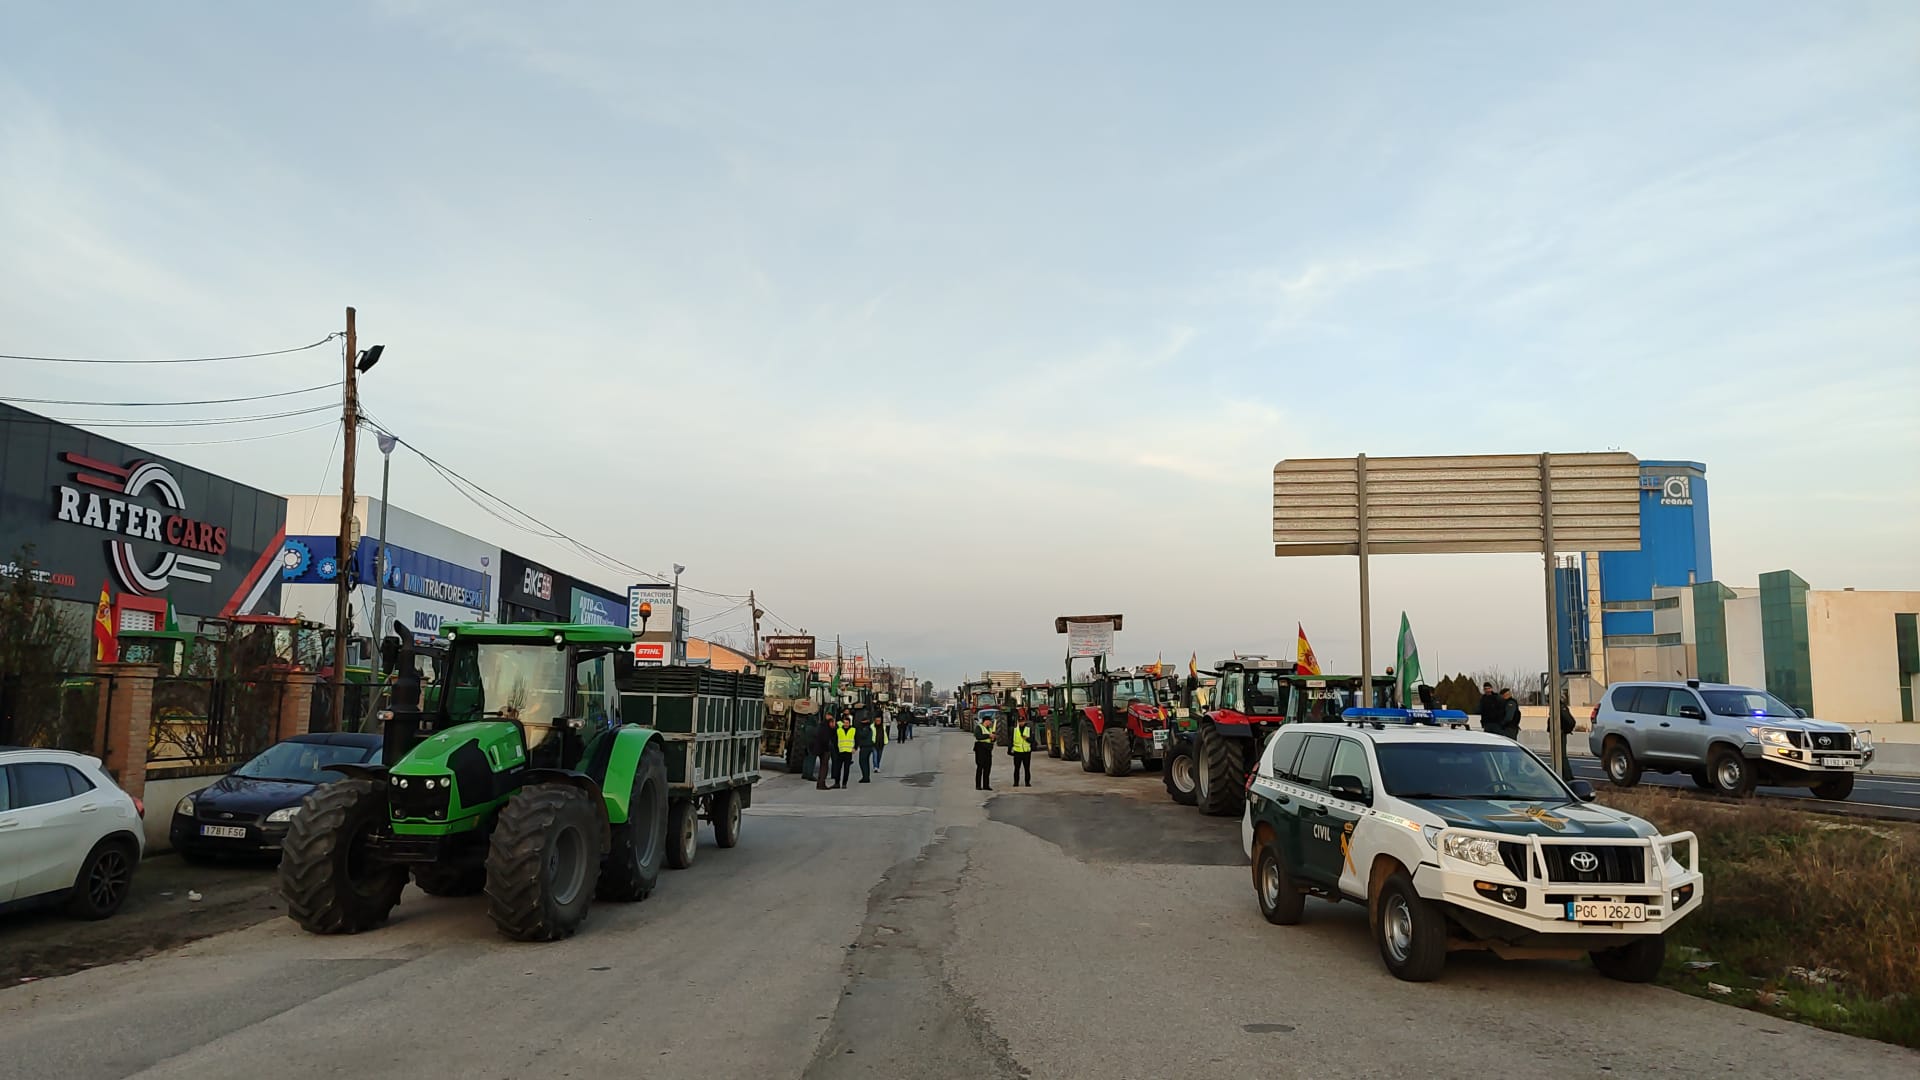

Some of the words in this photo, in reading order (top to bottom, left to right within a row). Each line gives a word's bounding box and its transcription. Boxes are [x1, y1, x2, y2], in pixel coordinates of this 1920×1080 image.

[57, 485, 162, 543] RAFER
[166, 514, 228, 556] CARS
[630, 591, 640, 627] MINI
[414, 610, 438, 631] BRICO
[1313, 824, 1331, 841] CIVIL
[1575, 904, 1598, 918] PGC
